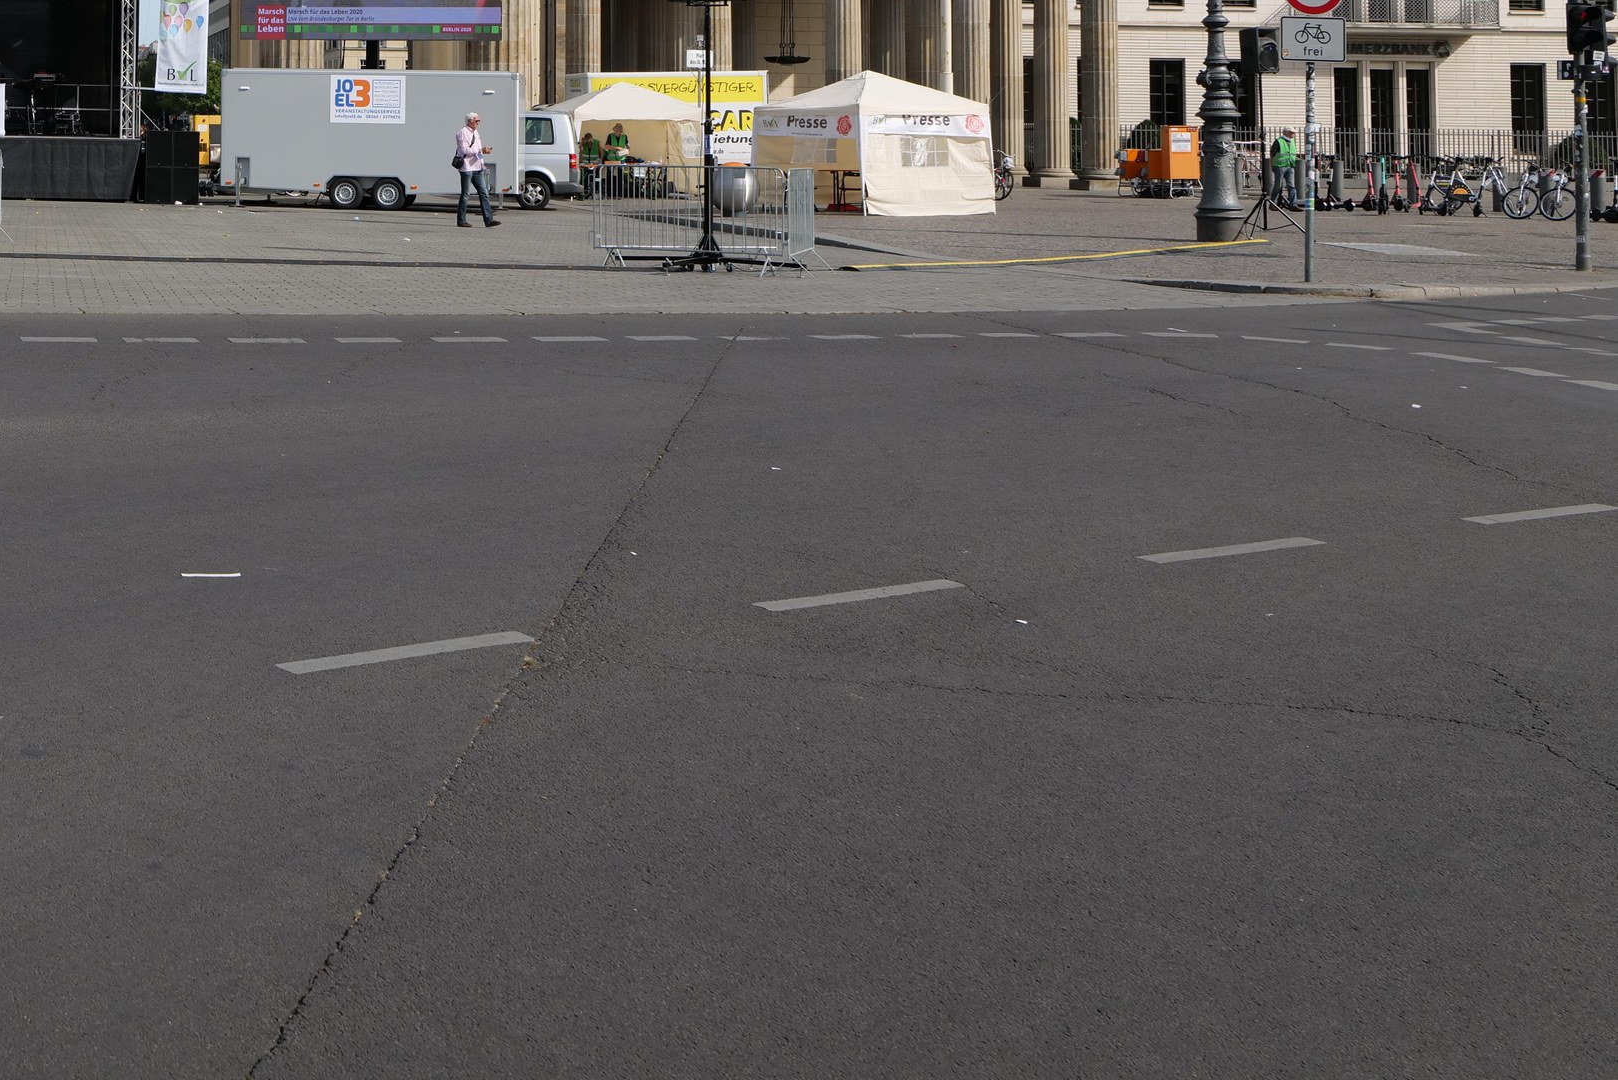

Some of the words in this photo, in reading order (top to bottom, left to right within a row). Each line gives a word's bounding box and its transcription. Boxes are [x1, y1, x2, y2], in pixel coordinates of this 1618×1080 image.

[258, 16, 270, 24] für
[257, 25, 285, 33] Leben
[1303, 46, 1324, 56] frei
[786, 115, 828, 129] Presse
